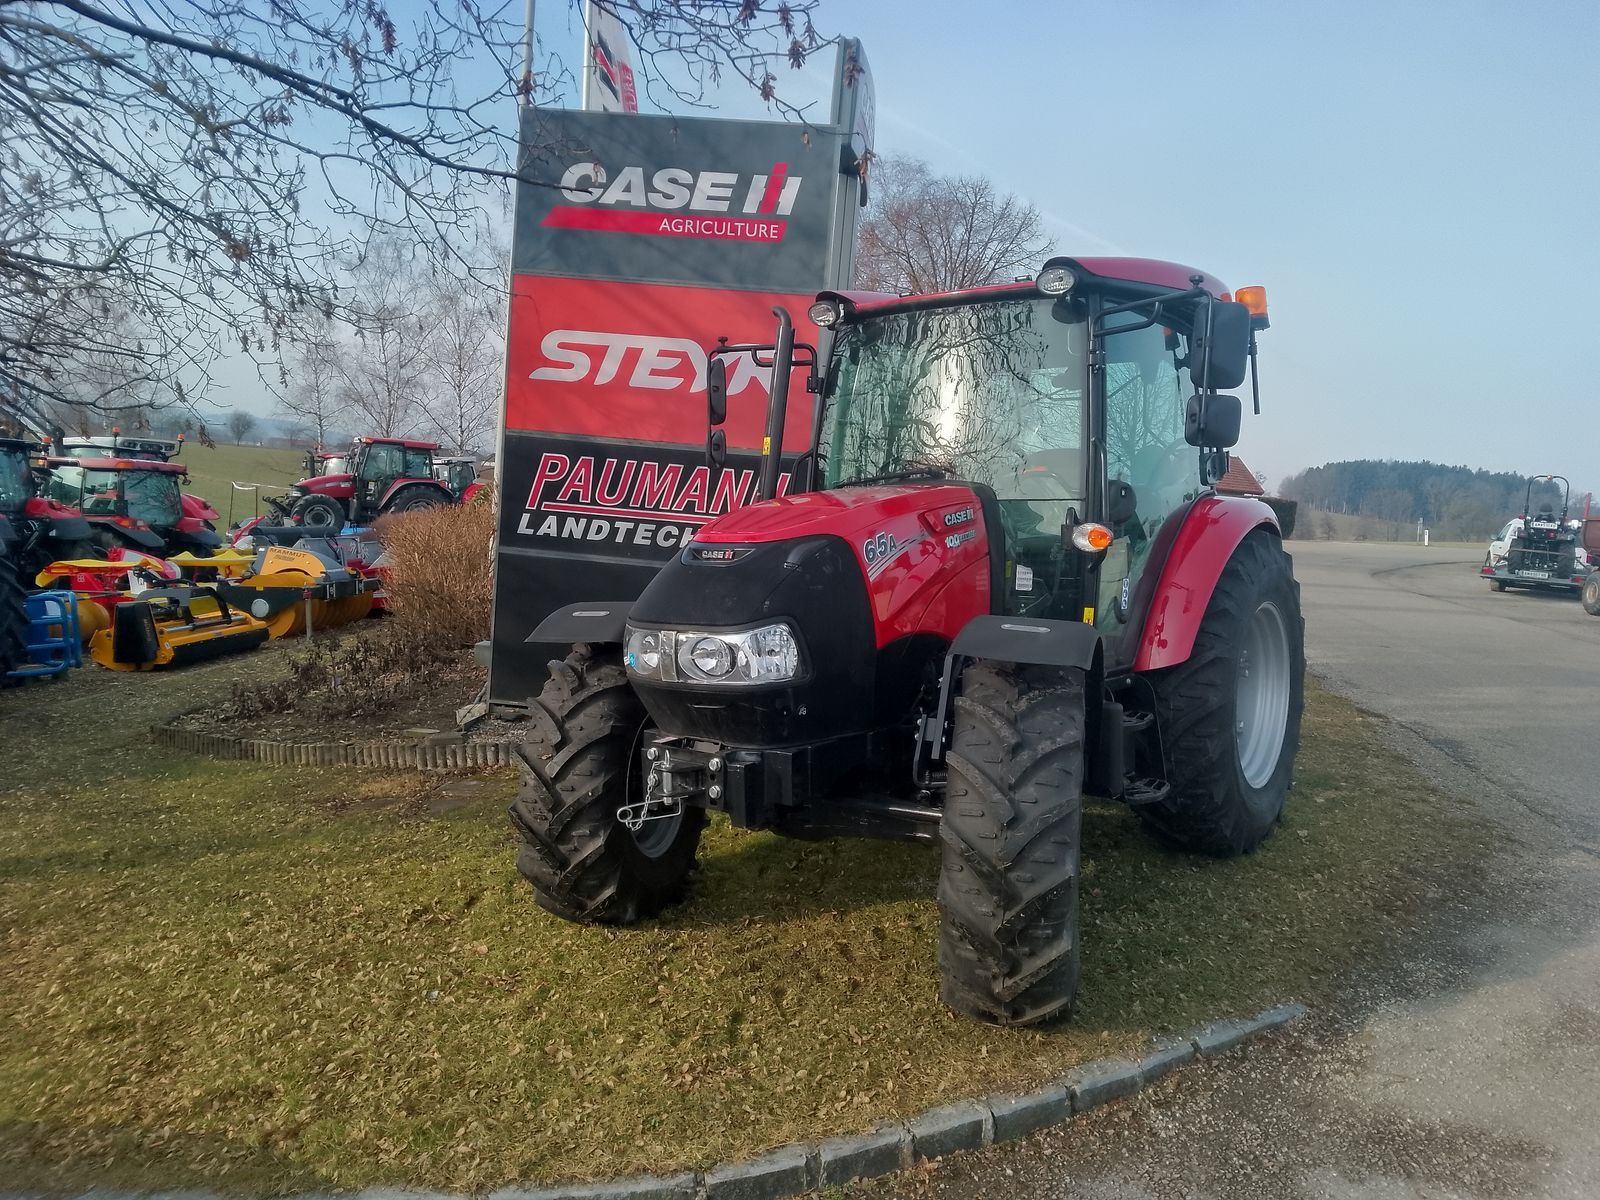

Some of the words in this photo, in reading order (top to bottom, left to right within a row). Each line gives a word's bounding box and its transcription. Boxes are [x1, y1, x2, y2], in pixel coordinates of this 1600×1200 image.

[560, 162, 741, 211] CASE
[659, 217, 778, 239] AGRICULTURE
[528, 330, 797, 396] STEYR
[944, 510, 967, 526] CASE
[269, 547, 307, 558] MAMMUT
[702, 551, 724, 559] CASE
[863, 532, 897, 563] 65A
